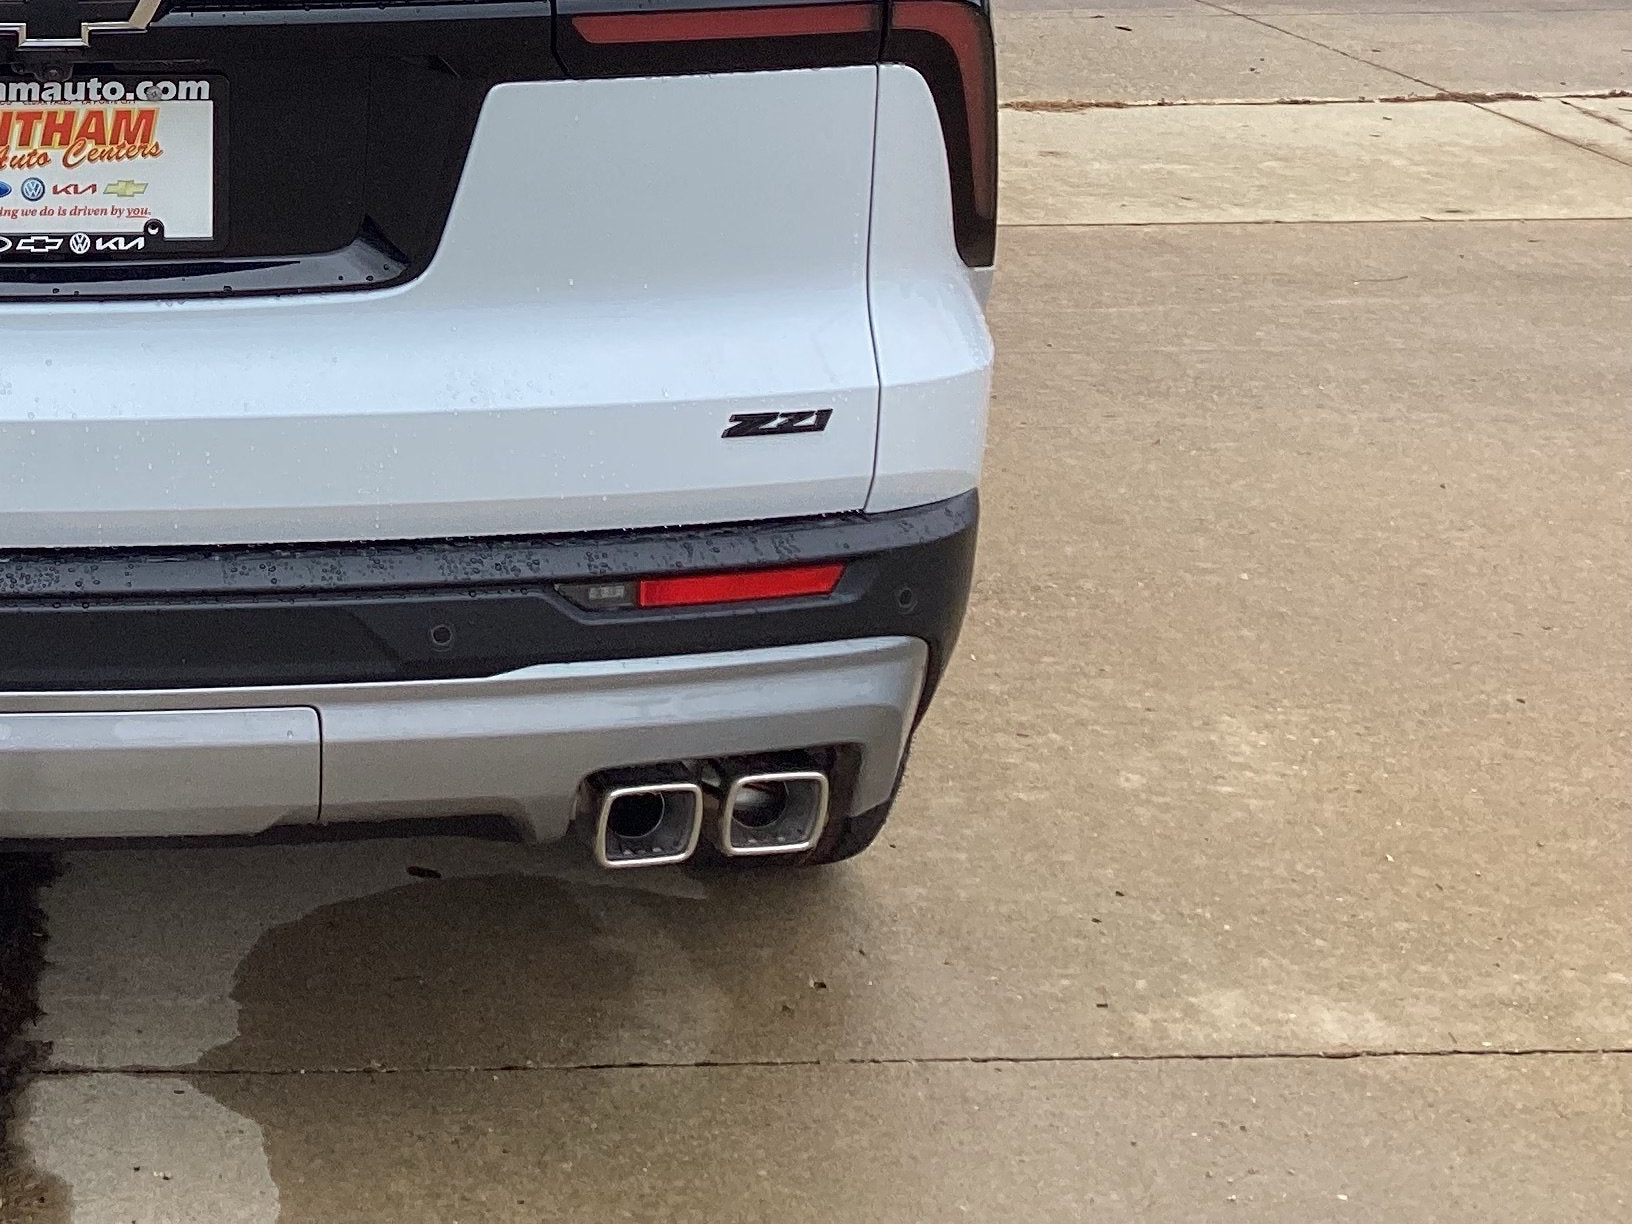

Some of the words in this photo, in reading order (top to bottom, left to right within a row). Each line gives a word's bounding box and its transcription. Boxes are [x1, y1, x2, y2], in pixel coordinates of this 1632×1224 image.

[62, 137, 163, 169] Centers
[20, 209, 37, 217] we
[39, 206, 55, 217] do
[57, 205, 67, 217] is
[69, 205, 108, 217] driven
[110, 205, 124, 219] by
